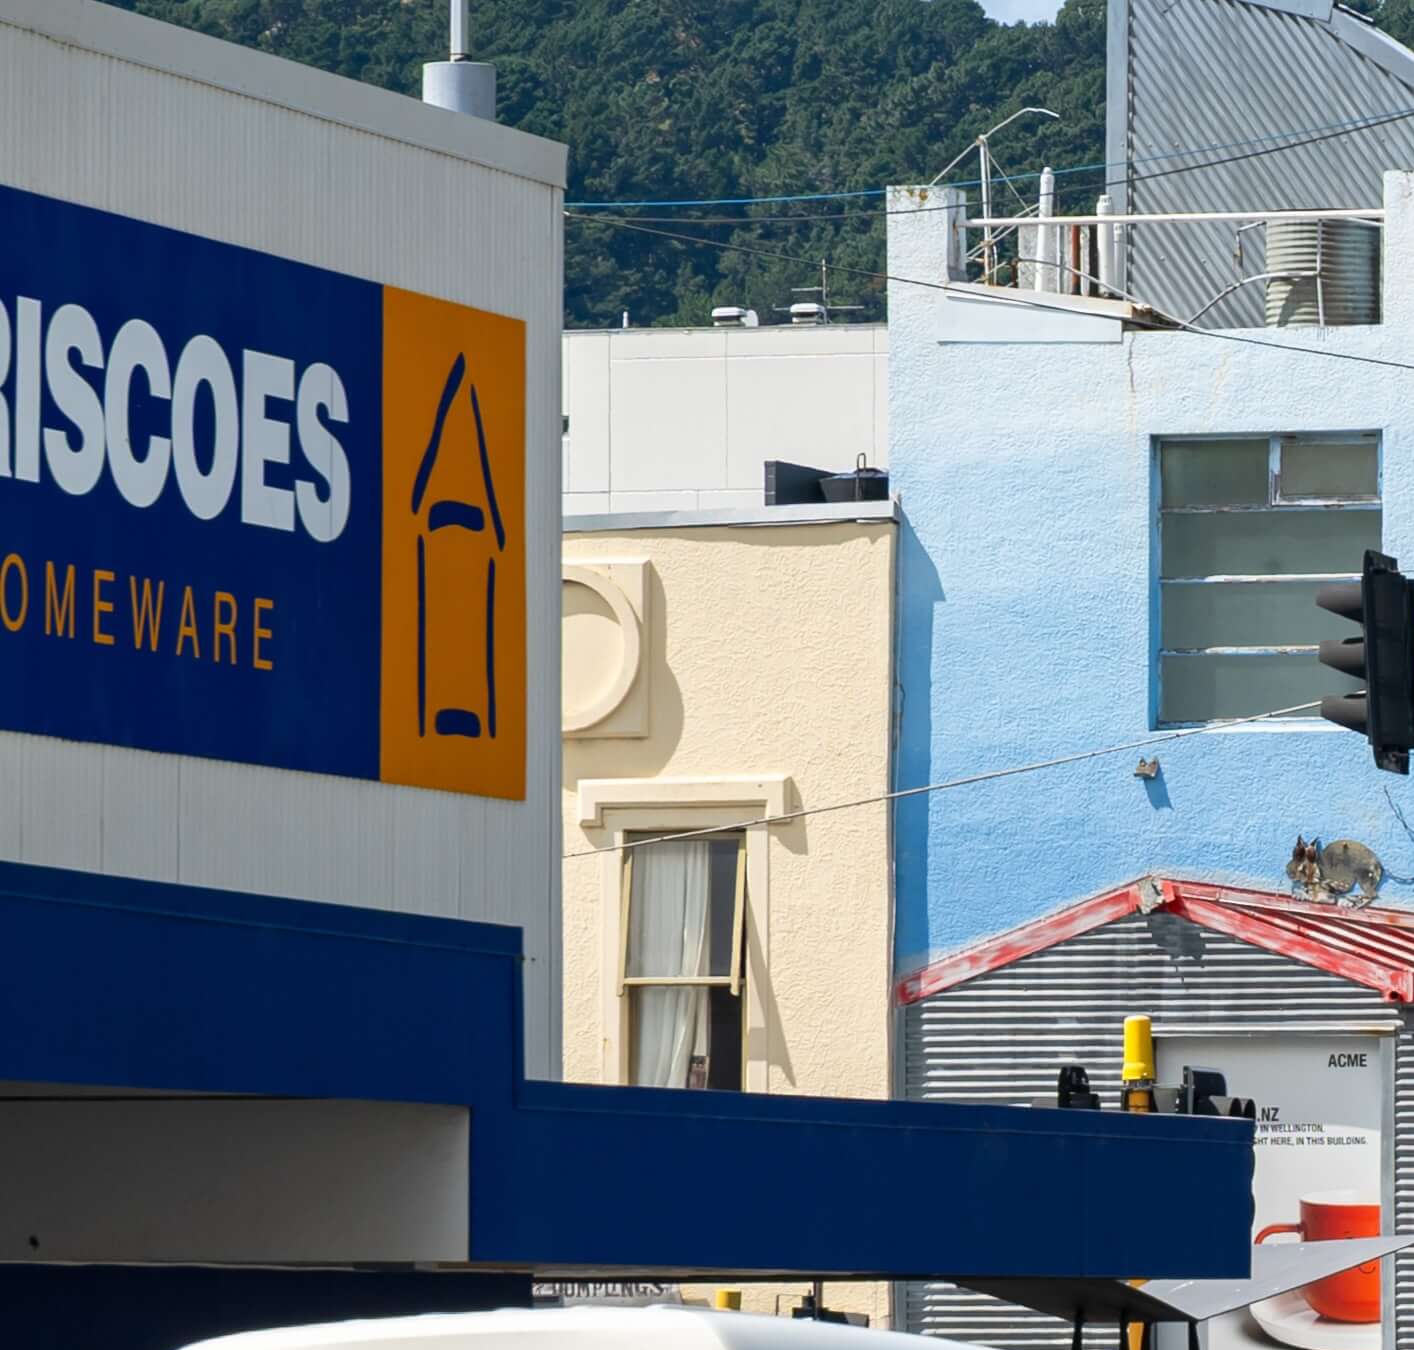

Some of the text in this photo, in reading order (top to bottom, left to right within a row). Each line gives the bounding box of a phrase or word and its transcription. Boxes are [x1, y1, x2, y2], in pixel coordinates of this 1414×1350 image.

[0, 295, 350, 543] ISCOES
[1328, 1053, 1367, 1067] ACME
[1307, 1137, 1325, 1145] THIS
